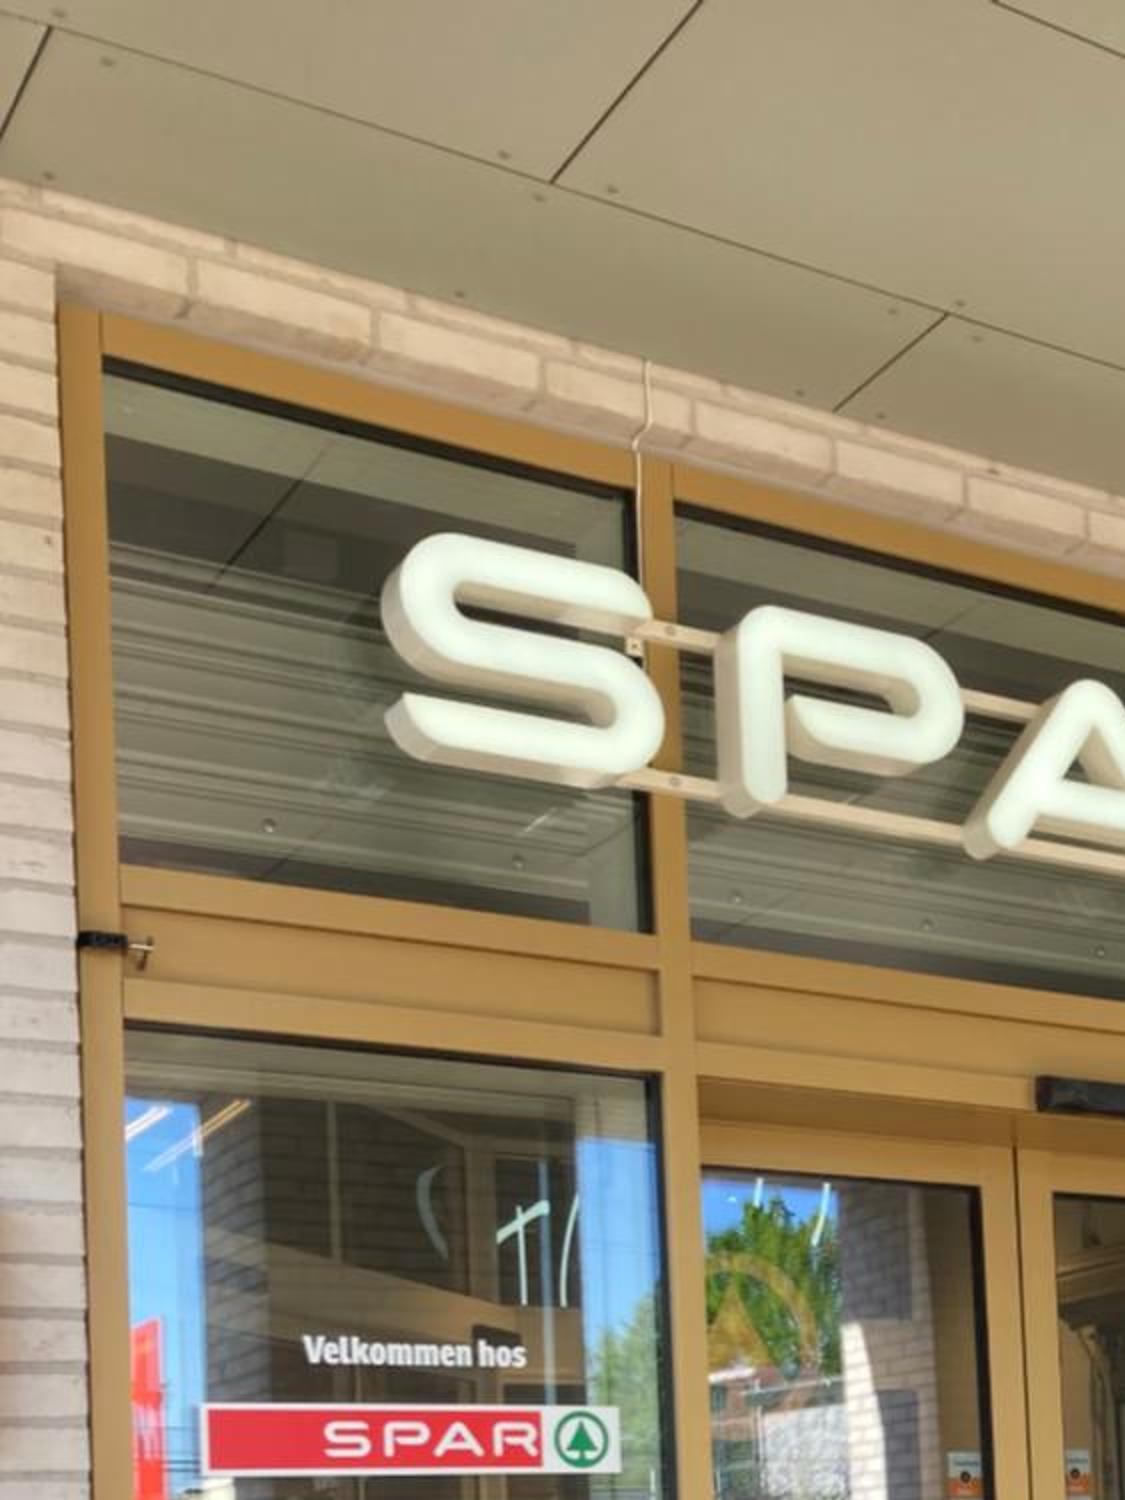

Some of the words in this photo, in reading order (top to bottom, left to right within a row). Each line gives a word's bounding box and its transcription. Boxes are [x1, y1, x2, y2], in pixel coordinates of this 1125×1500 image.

[302, 1334, 473, 1366] Velkommen
[477, 1339, 528, 1367] hos
[323, 1420, 539, 1458] SPAR
